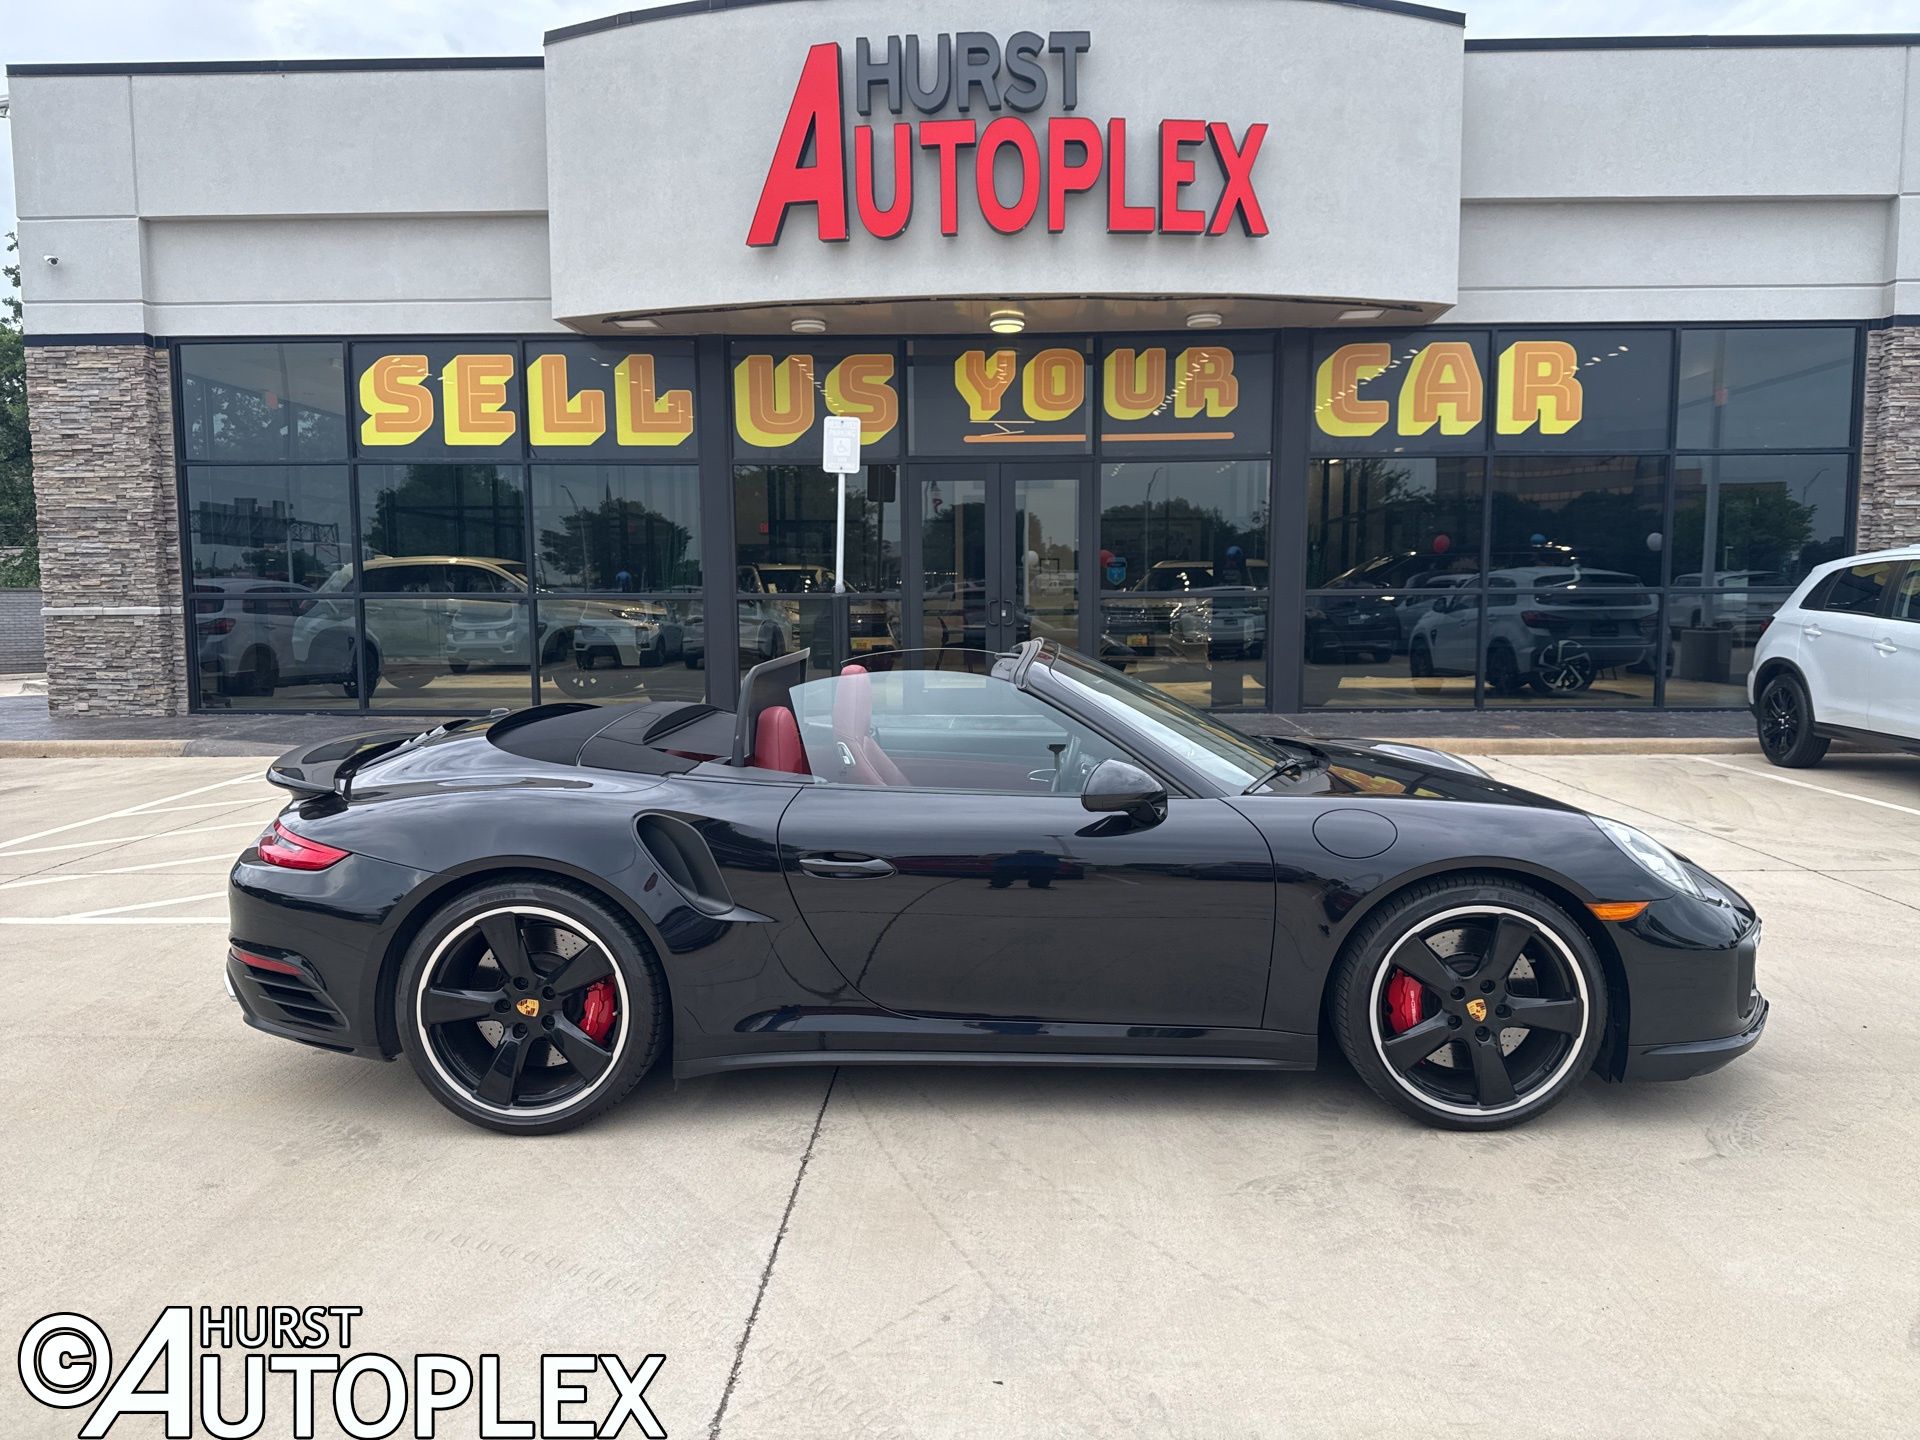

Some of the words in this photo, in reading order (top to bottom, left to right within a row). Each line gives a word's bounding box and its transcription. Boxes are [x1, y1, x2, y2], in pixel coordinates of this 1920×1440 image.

[856, 31, 1091, 116] HURST
[746, 42, 1269, 247] AUTOPLEX
[360, 354, 694, 446] SELL
[734, 353, 899, 447] US
[954, 346, 1239, 421] YOUR
[1315, 341, 1584, 437] CAR
